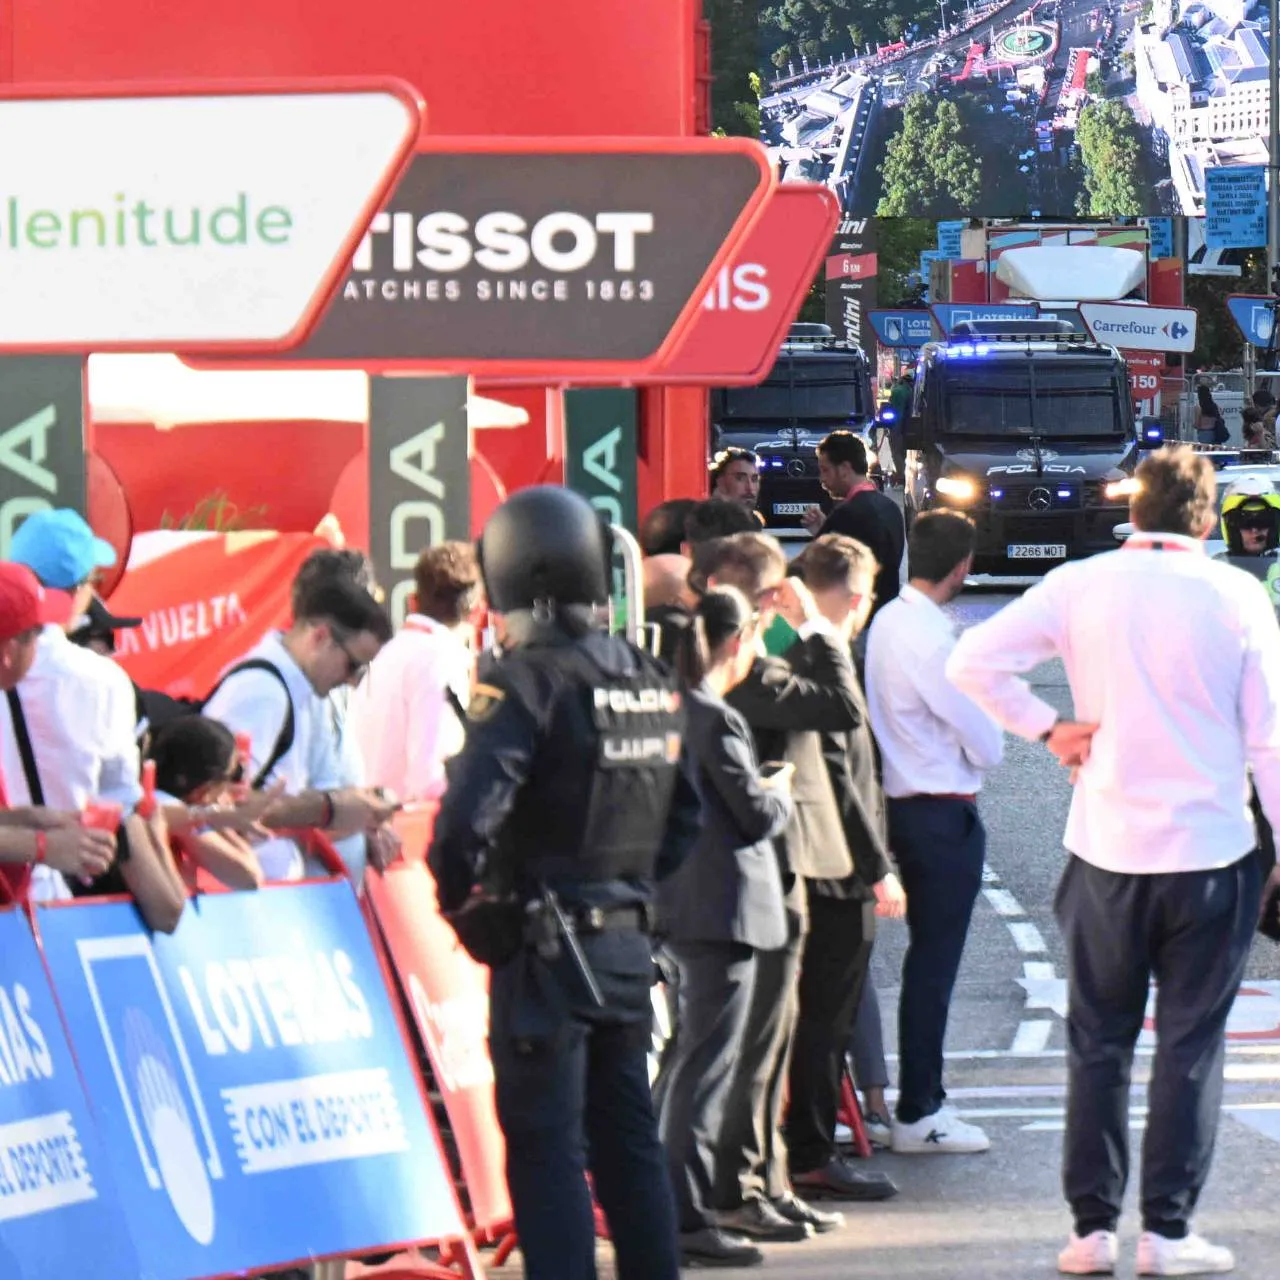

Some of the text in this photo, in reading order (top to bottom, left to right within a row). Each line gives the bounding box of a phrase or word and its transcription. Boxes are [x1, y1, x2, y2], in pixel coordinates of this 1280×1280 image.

[0, 190, 293, 249] lenitude
[352, 211, 654, 272] TISSOT
[476, 279, 568, 301] SINCE
[585, 279, 655, 301] 1853
[1092, 318, 1157, 336] Carrefour
[1131, 375, 1157, 389] 150
[1014, 546, 1042, 557] 2266
[141, 592, 248, 651] VUELTA
[245, 1102, 291, 1150] CON
[290, 1097, 318, 1143] EL
